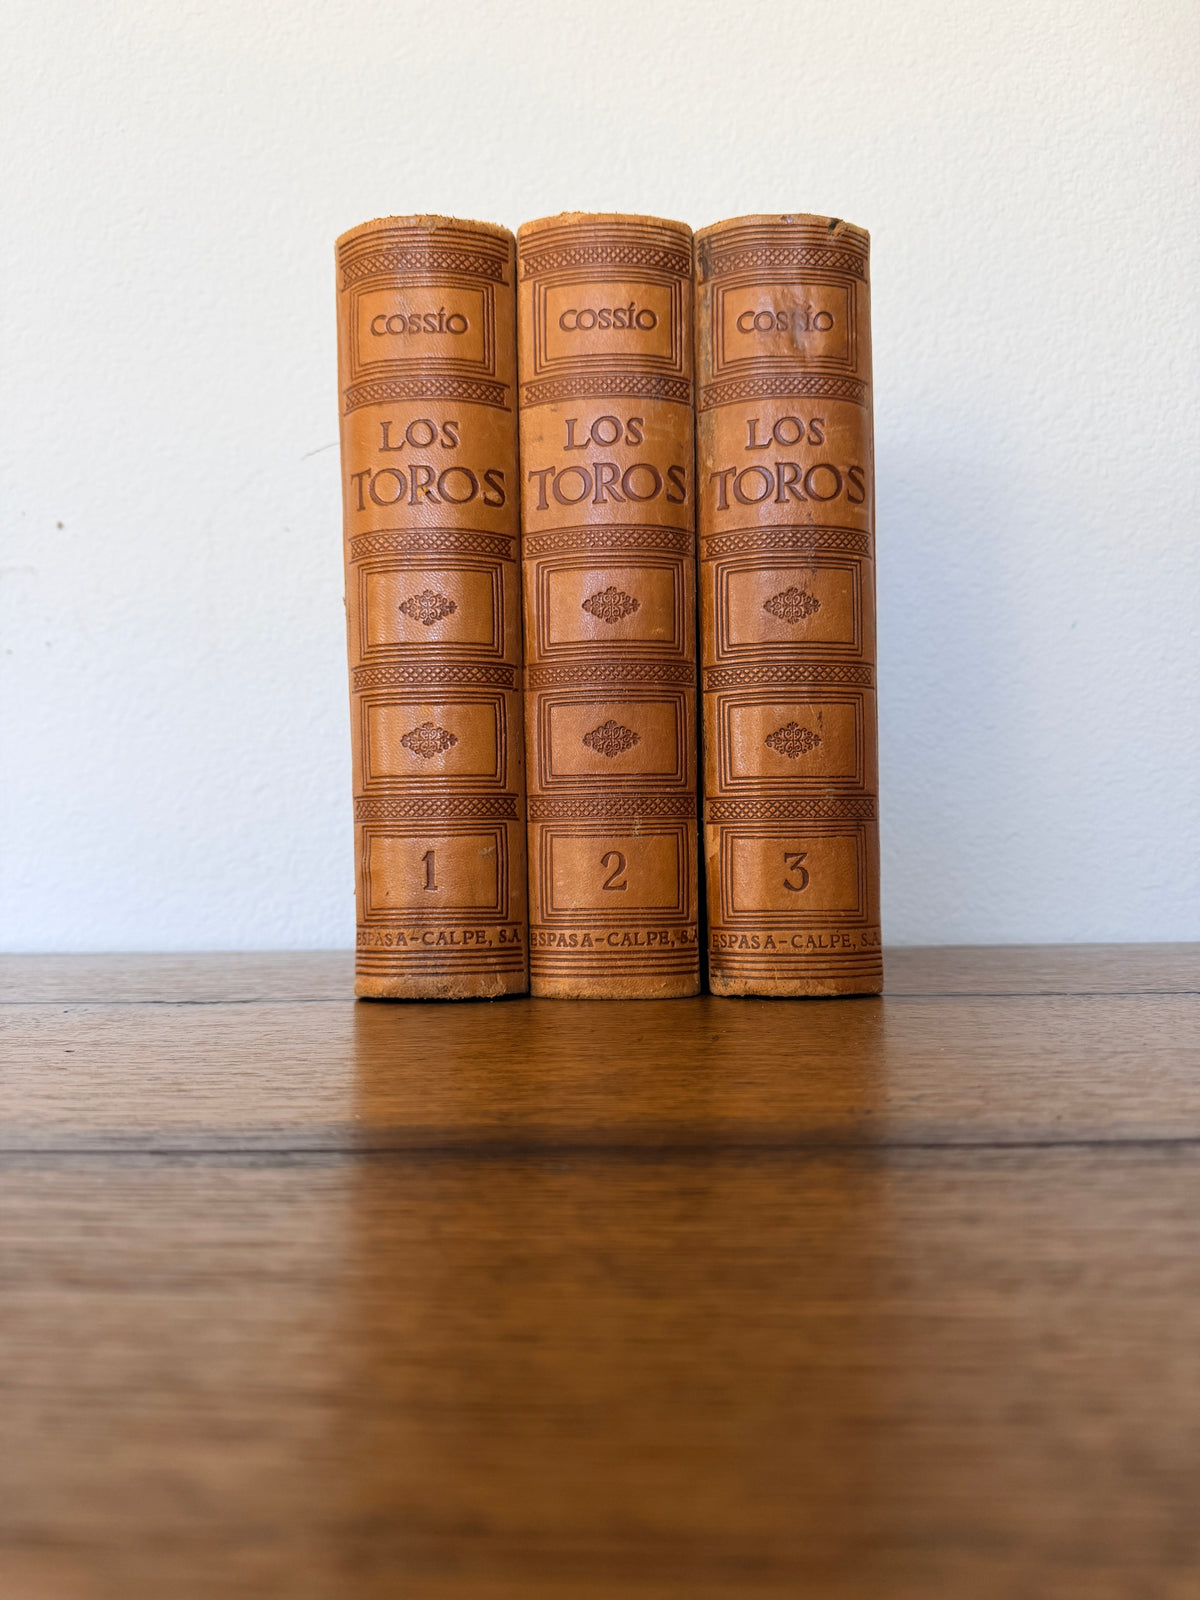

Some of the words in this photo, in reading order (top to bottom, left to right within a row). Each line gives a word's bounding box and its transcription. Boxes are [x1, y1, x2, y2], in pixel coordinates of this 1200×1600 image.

[737, 305, 834, 333] COSÍO
[378, 418, 460, 452] LOS
[563, 415, 644, 451] LOS
[744, 416, 825, 450] LOS
[351, 464, 505, 512] TOROS
[528, 462, 687, 510] TOROS
[709, 462, 865, 511] TOROS
[421, 850, 438, 891] 1
[600, 850, 628, 891] 2
[783, 852, 810, 892] 3
